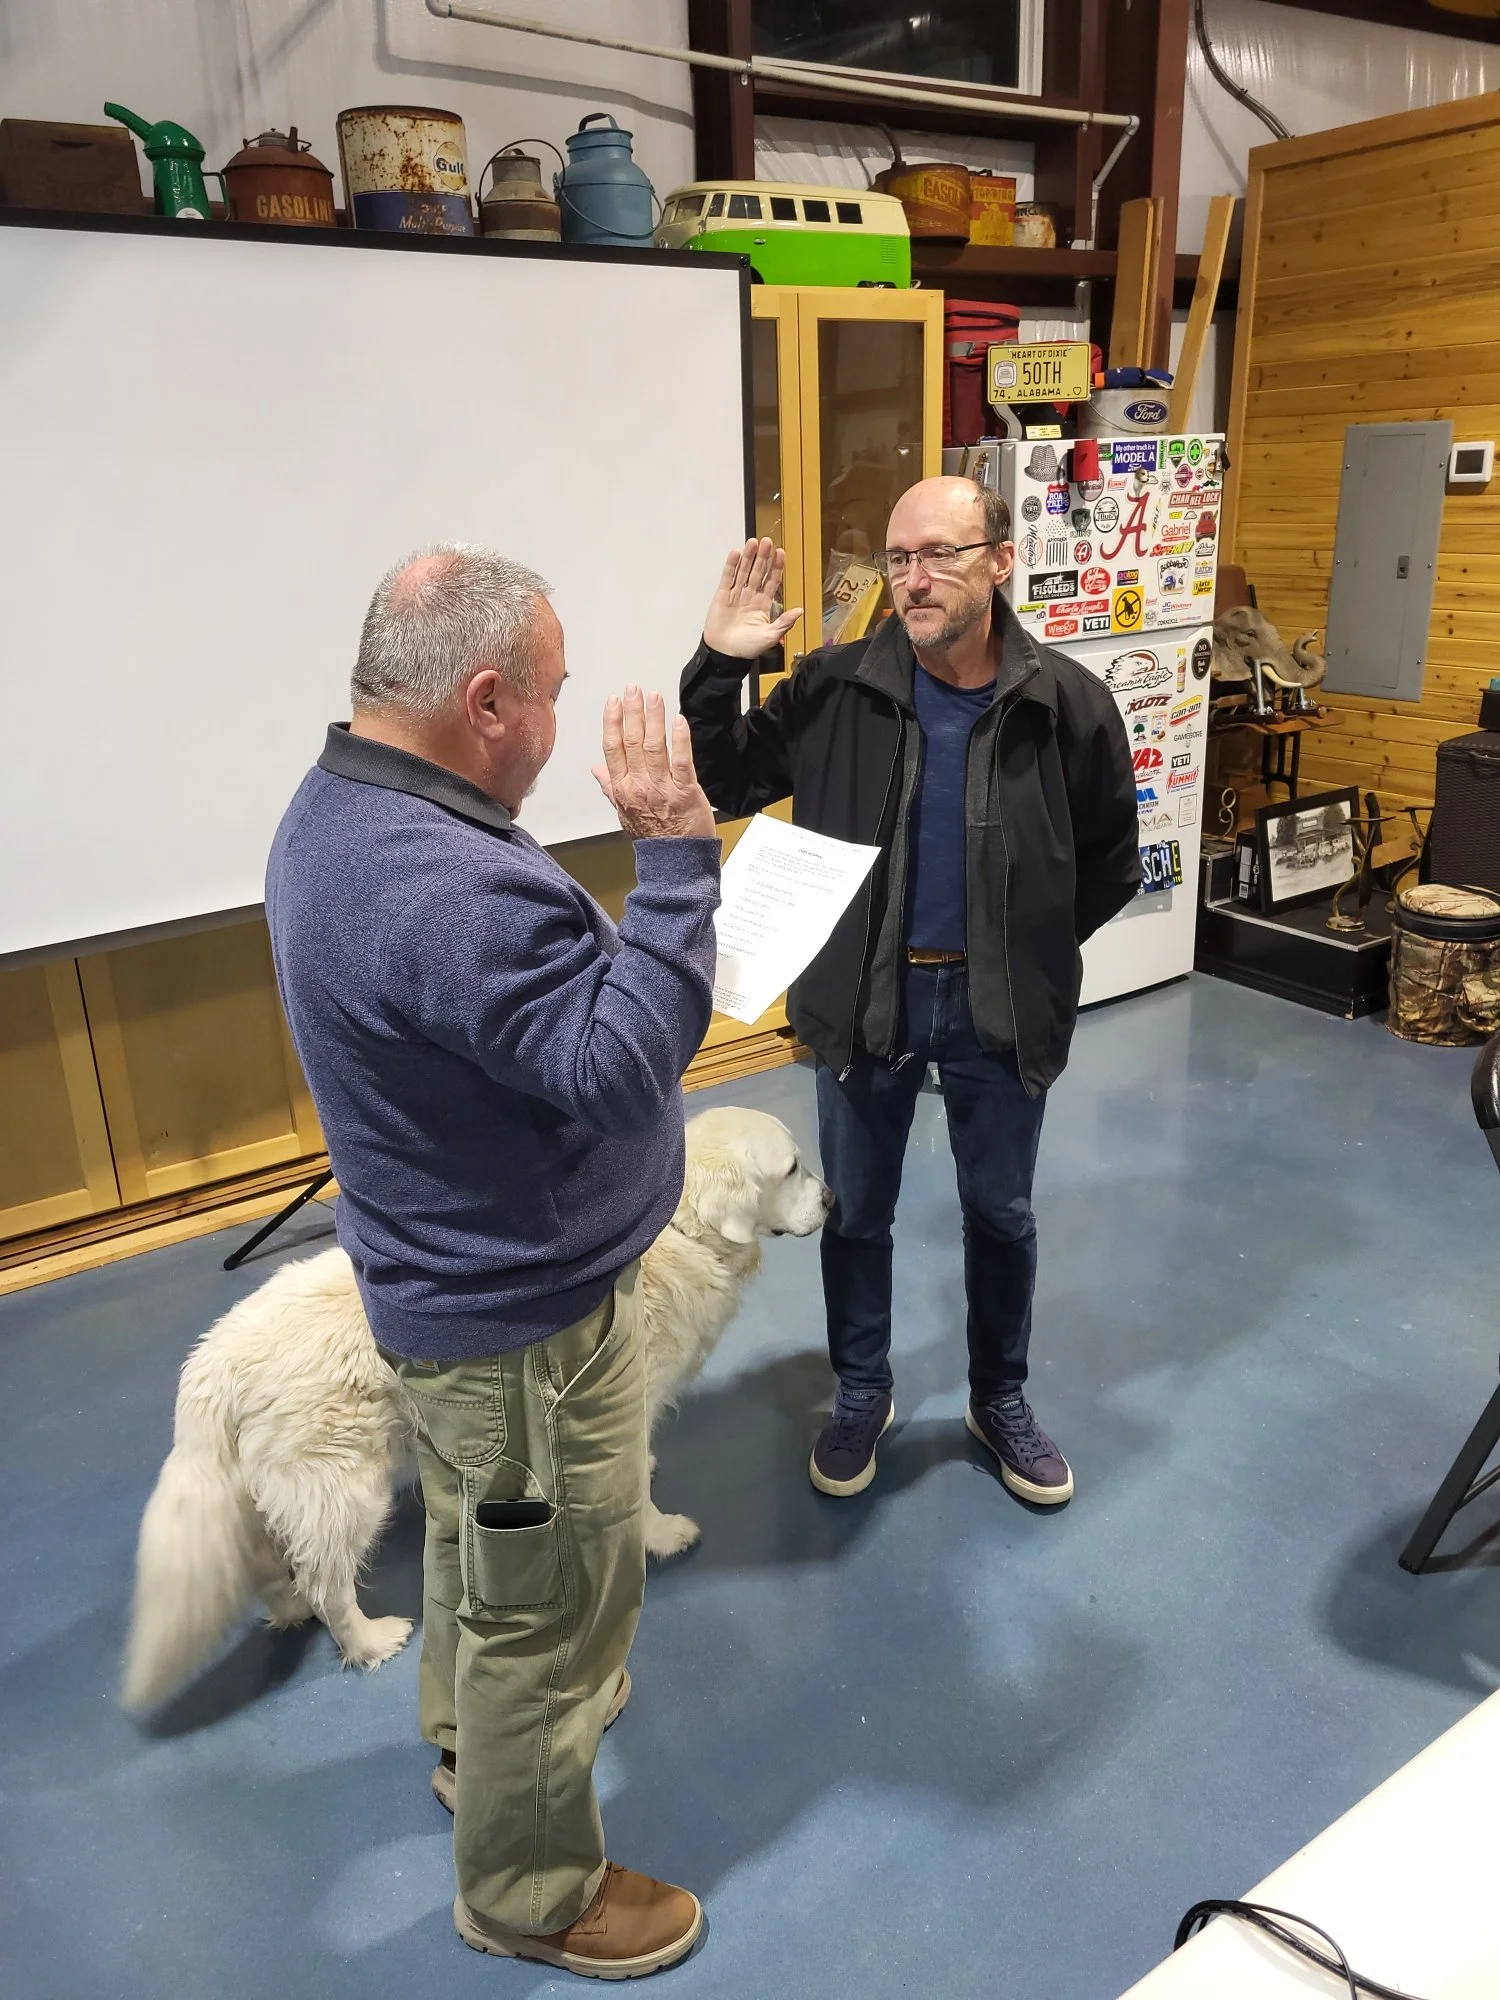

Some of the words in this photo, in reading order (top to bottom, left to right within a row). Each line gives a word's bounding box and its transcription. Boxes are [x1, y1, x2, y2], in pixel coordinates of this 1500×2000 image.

[1012, 350, 1036, 359] HEART
[1037, 350, 1046, 359] OF
[1048, 349, 1067, 358] DIXIE
[1023, 361, 1061, 385] 50TH
[993, 389, 1005, 399] 74
[1017, 388, 1061, 397] ALABAMA
[1134, 403, 1161, 421] Ford
[1115, 444, 1122, 452] My
[1115, 452, 1147, 464] MODEL
[1148, 451, 1155, 462] A
[1049, 492, 1069, 500] ROAD
[1047, 499, 1070, 507] TRIPS
[1161, 522, 1191, 537] Gabriel
[835, 579, 859, 603] 29
[1048, 621, 1075, 634] Weego
[1085, 616, 1109, 630] YETI
[1143, 670, 1168, 685] Eagle
[1125, 695, 1173, 715] KLOTZ
[1174, 730, 1203, 742] GAMEBORE
[1172, 755, 1190, 767] YETI
[1167, 769, 1198, 790] SUMMIT
